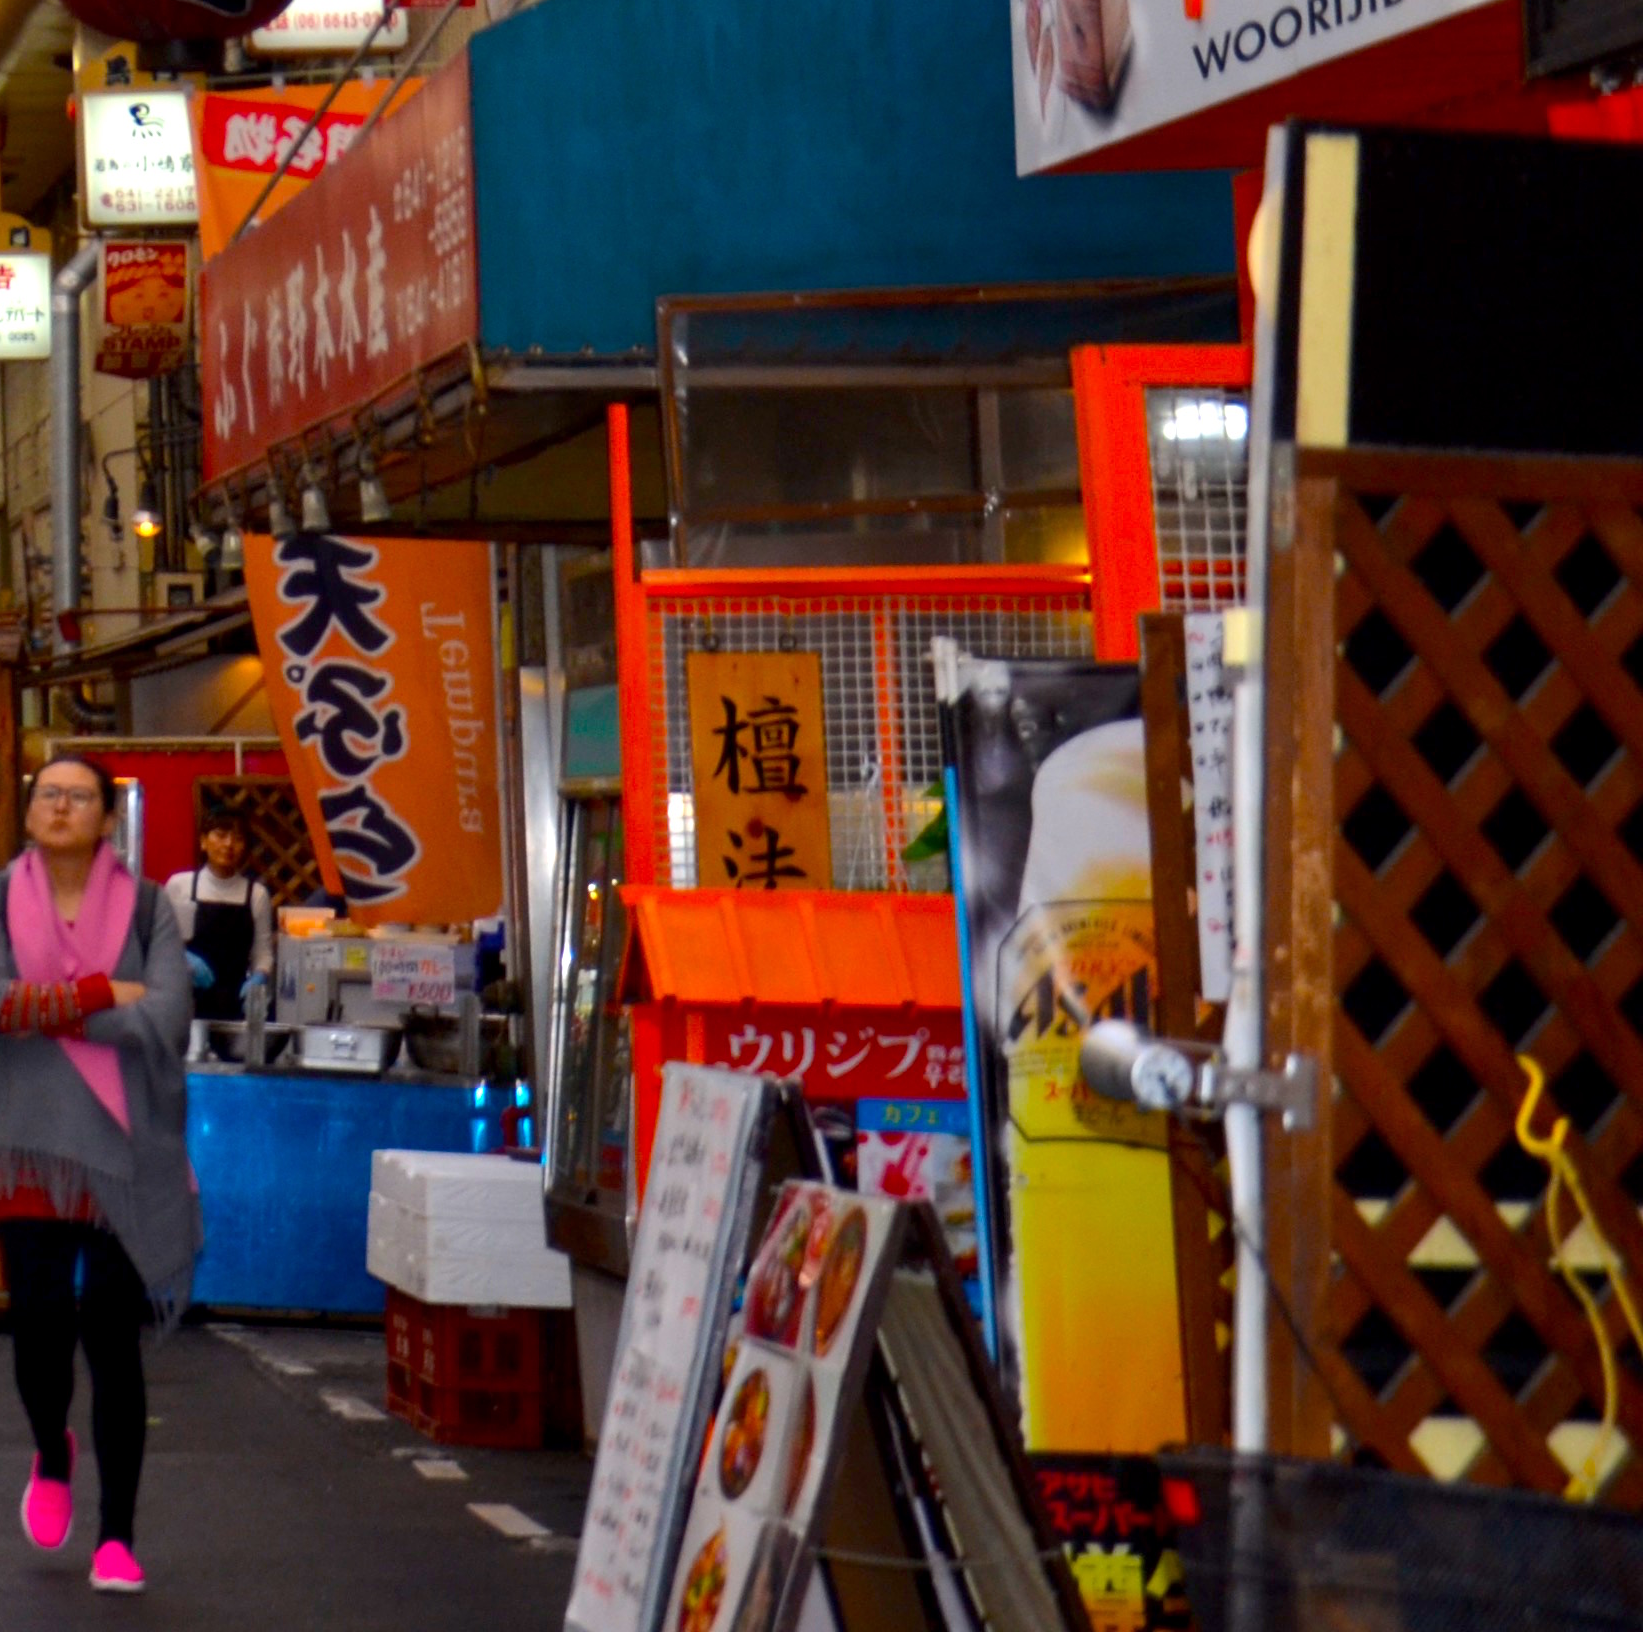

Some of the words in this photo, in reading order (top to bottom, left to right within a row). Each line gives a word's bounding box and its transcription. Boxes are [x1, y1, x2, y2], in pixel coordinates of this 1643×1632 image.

[106, 248, 158, 266] クロモン
[728, 1024, 931, 1079] ウリジプ
